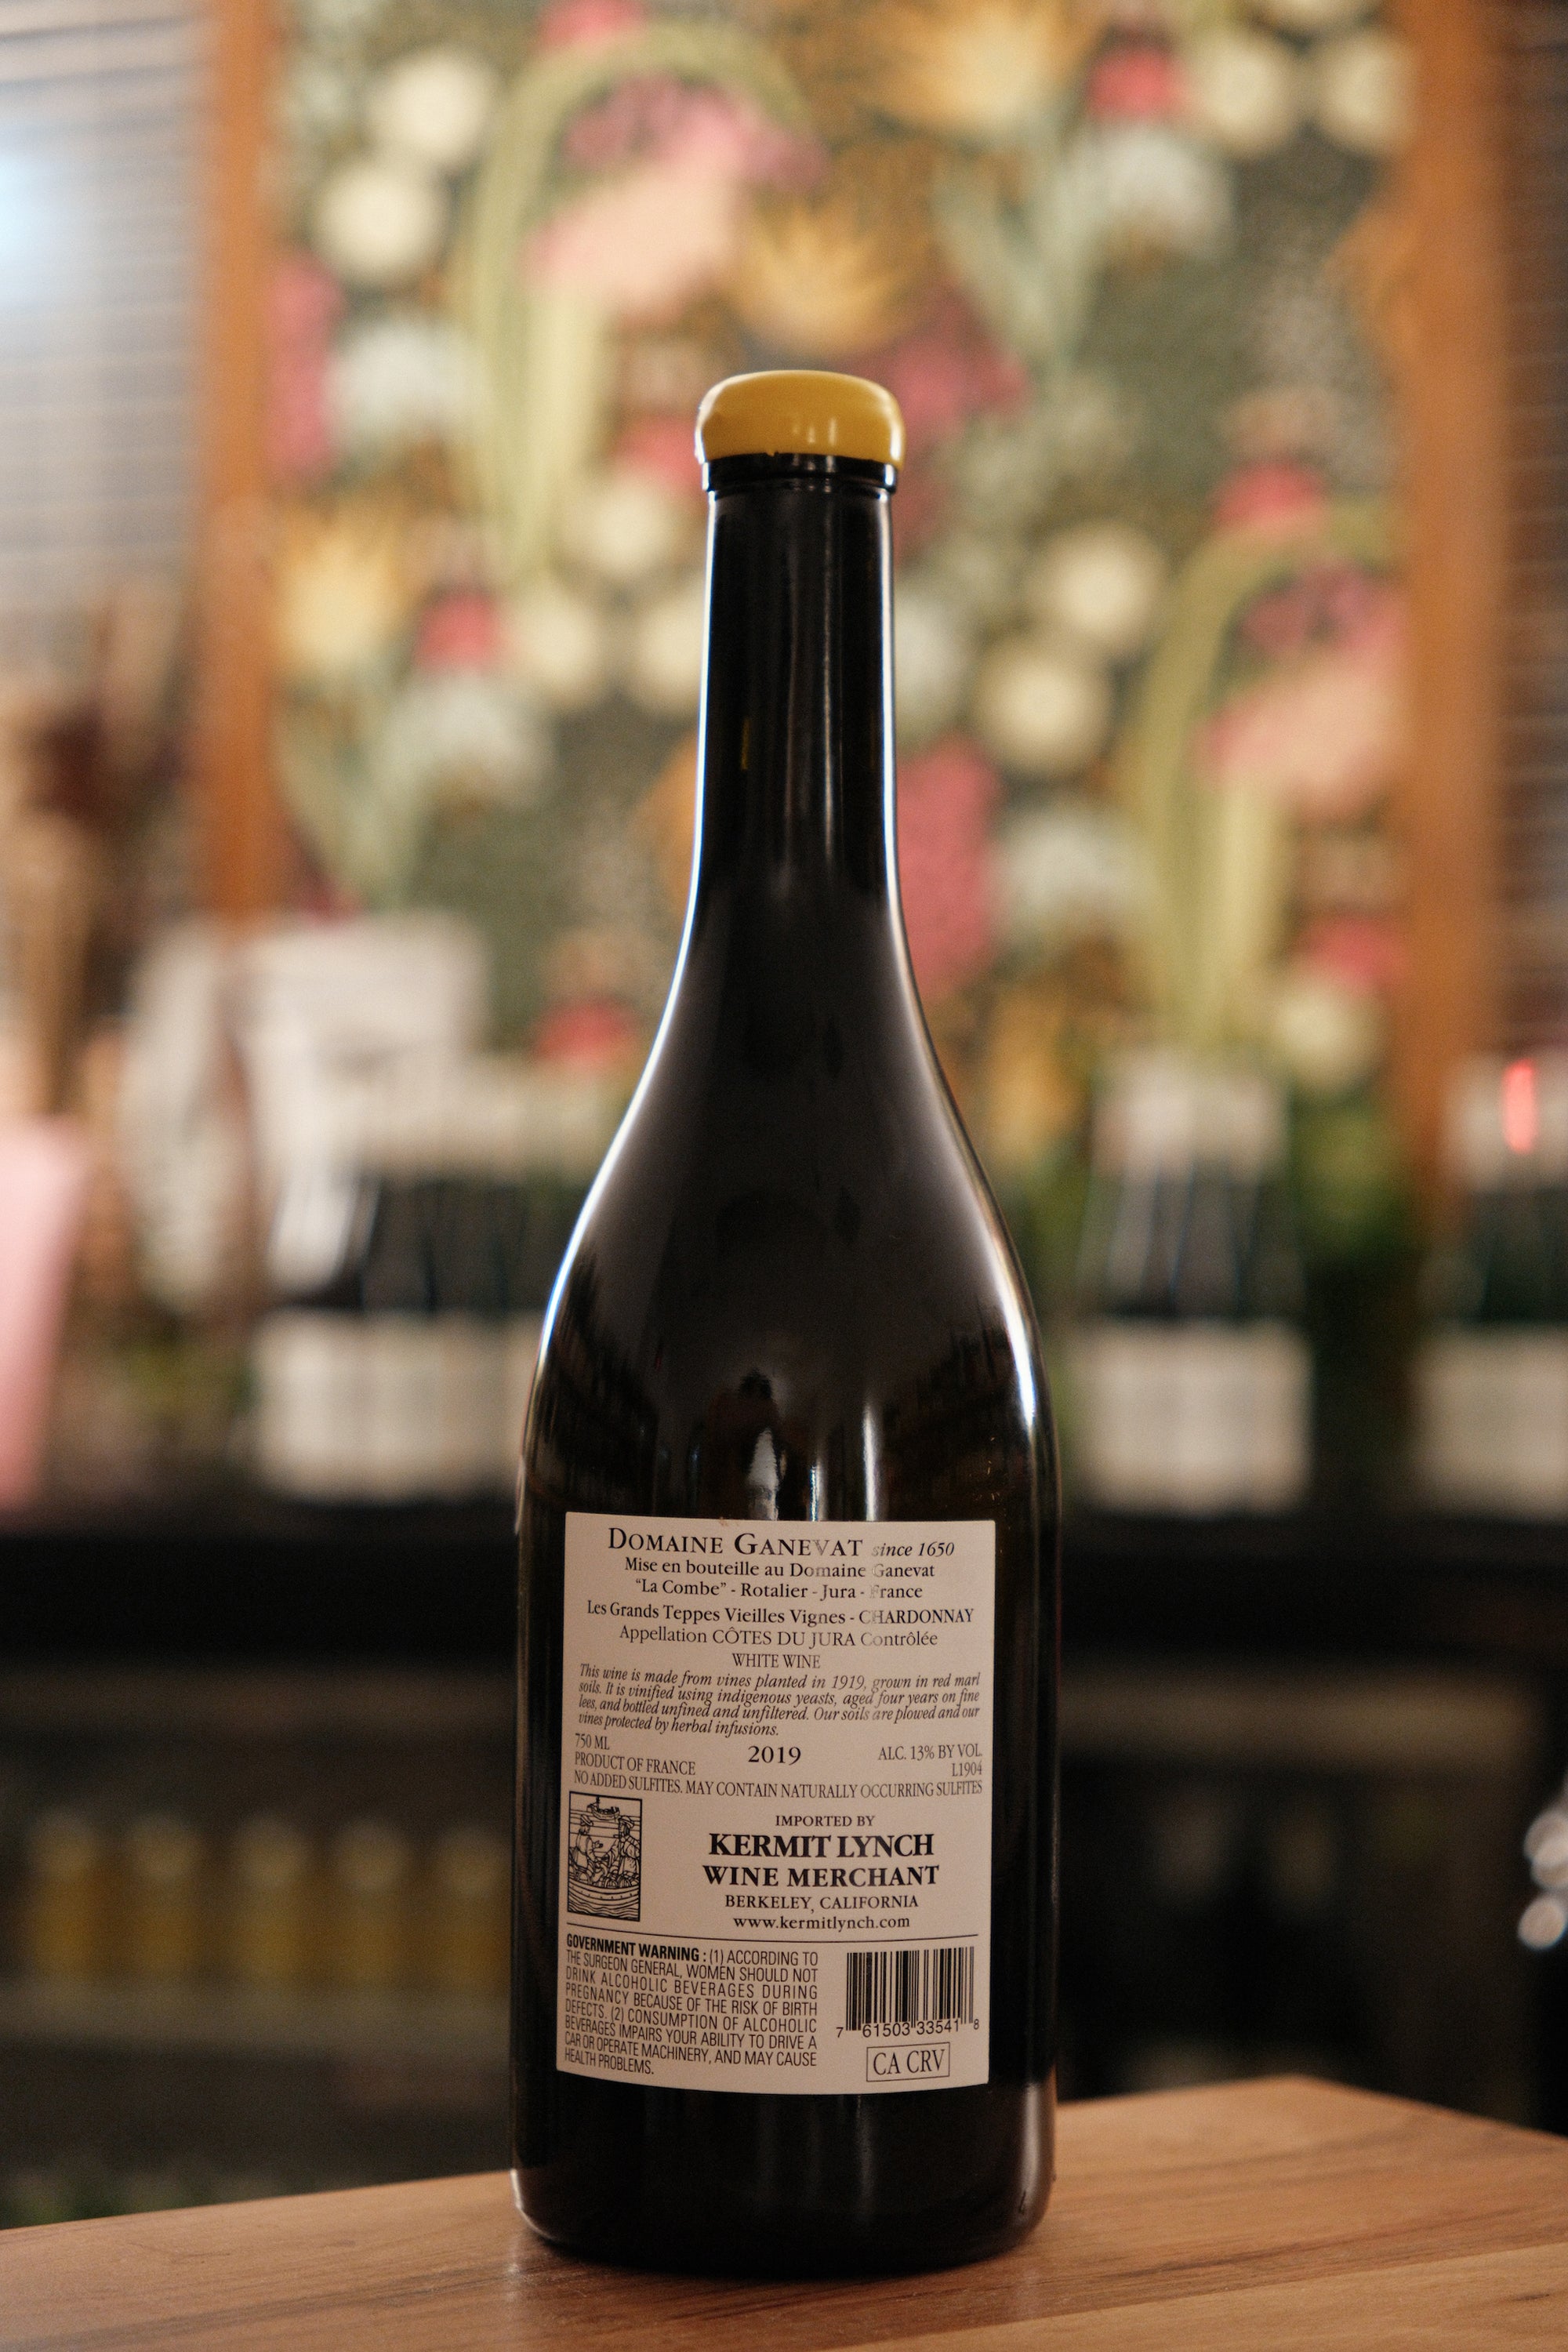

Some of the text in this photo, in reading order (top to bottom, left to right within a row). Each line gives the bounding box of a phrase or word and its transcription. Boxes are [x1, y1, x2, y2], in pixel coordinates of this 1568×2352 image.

[608, 1528, 723, 1553] DOMAINE
[872, 1543, 912, 1556] since
[918, 1542, 954, 1557] 1650
[625, 1557, 935, 1577] Mise en bouteille au Domaine Ganevat
[741, 1583, 808, 1598] Rotalier
[820, 1584, 856, 1601] Jura
[870, 1584, 922, 1598] France
[587, 1600, 606, 1615] Les
[610, 1602, 659, 1618] Grands
[663, 1605, 720, 1624] Teppes
[724, 1607, 785, 1624] Vieilles
[790, 1610, 845, 1627] Vignes
[859, 1609, 974, 1624] CHARDONNAY
[619, 1625, 938, 1649] Appellation CÔTES DU JURA Contrôlée
[732, 1653, 820, 1668] WHITE WINE
[580, 1664, 599, 1678] This
[603, 1667, 627, 1681] wine
[631, 1669, 640, 1682] is
[644, 1670, 677, 1684] made
[681, 1671, 712, 1688] from
[717, 1673, 750, 1686] vines
[754, 1674, 808, 1691] planted
[812, 1676, 826, 1688] in
[872, 1676, 911, 1693] grown
[916, 1675, 927, 1687] in
[933, 1674, 951, 1686] red
[955, 1672, 980, 1686] marl
[579, 1682, 979, 1709] soils. It is vinified using indigenous yeasts, aged four years on fine
[579, 1695, 979, 1723] lees, and bottled unfined and unfiltered. Our soils are plowed and our
[579, 1712, 779, 1738] vines protected by herbal infusions.
[575, 1733, 610, 1750] 750 ML
[878, 1744, 982, 1761] ALC. 13% BY VOL.
[575, 1751, 695, 1775] PRODUCT OF FRANCE
[748, 1746, 801, 1765] 2019
[952, 1762, 982, 1777] L1904
[575, 1770, 982, 1798] NO ADDED SULFITES. MAY CONTAIN NATURALLY OCCURRING SULFITES
[775, 1815, 875, 1827] IMPORTED BY
[709, 1833, 935, 1857] KERMIT LYNCH
[702, 1864, 939, 1887] WINE MERCHANT
[725, 1895, 919, 1913] BERKELEY, CALIFORNIA
[733, 1916, 909, 1933] www.kermitlynch.com
[567, 1933, 636, 1957] GOVERNMENT
[639, 1944, 699, 1962] WARNING
[710, 1950, 724, 1965] (1)
[727, 1950, 798, 1965] ACCORDING
[804, 1952, 818, 1965] TO
[567, 1950, 818, 1983] THE SURGEON GENERAL, WOMEN SHOULD NOT
[566, 1966, 817, 1999] DRINK ALCOHOLIC BEVERAGES DURING
[566, 1982, 817, 2016] PREGNANCY BECAUSE OF THE RISK OF BIRTH
[565, 1998, 817, 2033] DEFECTS. (2) CONSUMPTION OF ALCOHOLIC
[565, 2015, 817, 2049] BEVERAGES IMPAIRS YOUR ABILITY TO DRIVE A
[836, 2019, 979, 2038] 7 61503 33541 8
[564, 2049, 654, 2074] HEALTH PROBLEMS.
[565, 2031, 817, 2067] CAR OR OPERATE MACHINERY, AND MAY CAUSE
[873, 2049, 945, 2075] CA CRV
